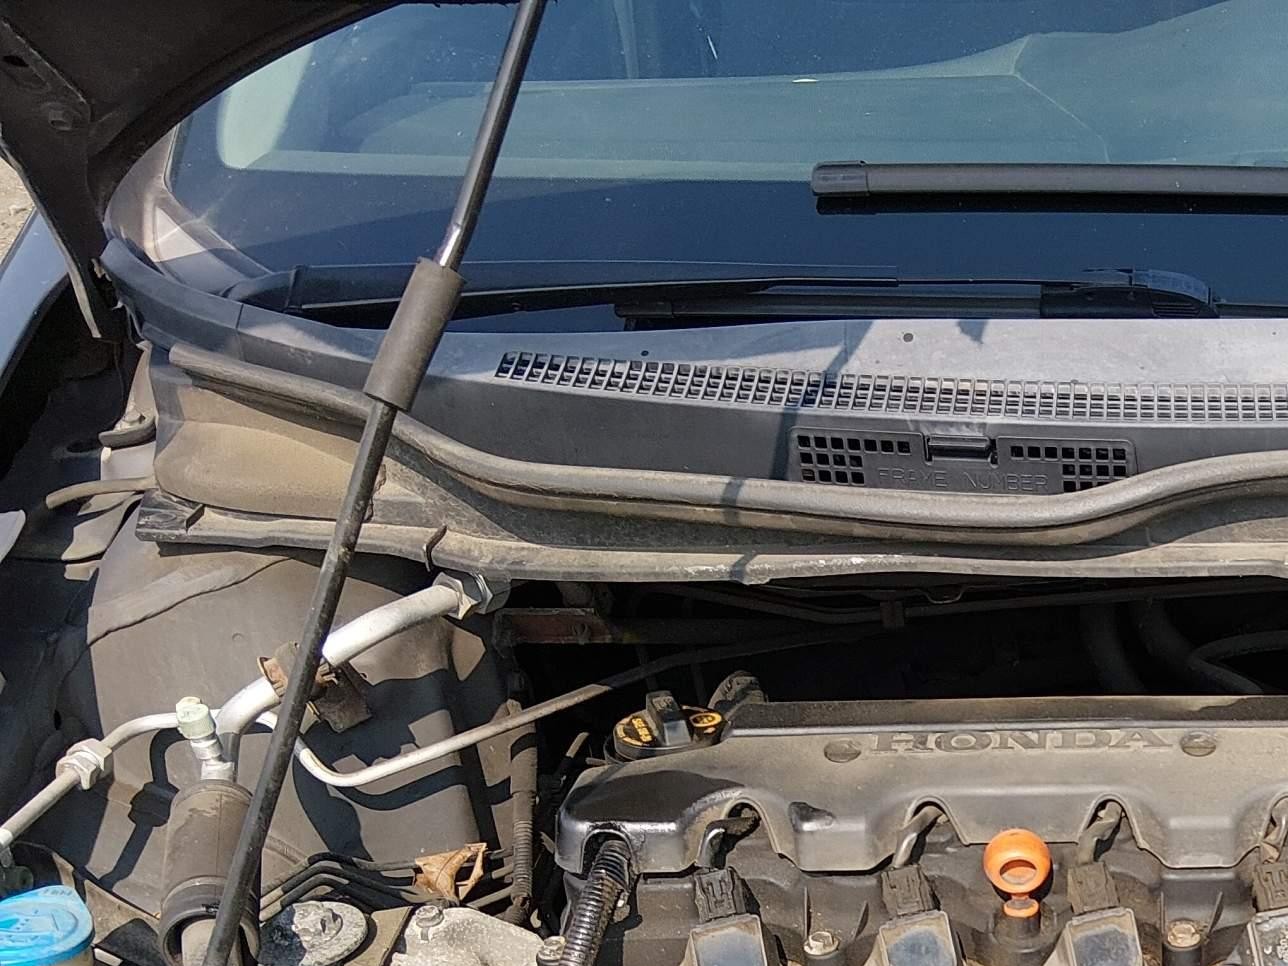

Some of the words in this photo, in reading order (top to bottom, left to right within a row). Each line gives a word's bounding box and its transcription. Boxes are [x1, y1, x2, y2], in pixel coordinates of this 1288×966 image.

[877, 467, 948, 488] FRAME
[962, 470, 1049, 492] NUMBER
[873, 728, 1173, 753] HONDA
